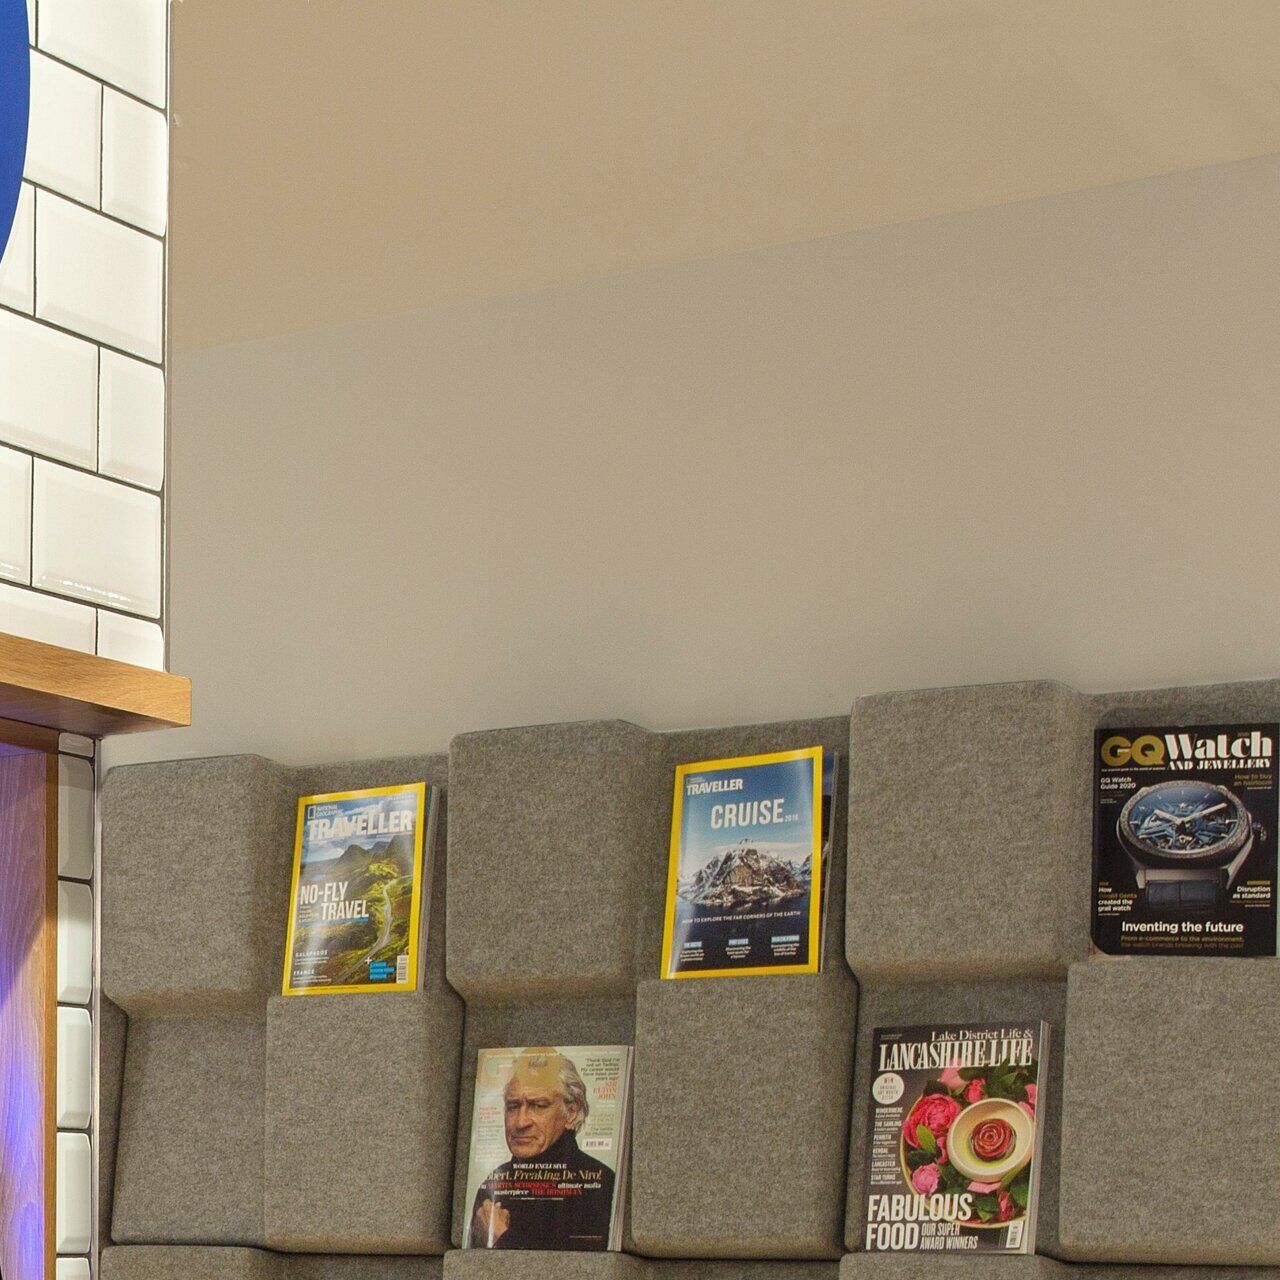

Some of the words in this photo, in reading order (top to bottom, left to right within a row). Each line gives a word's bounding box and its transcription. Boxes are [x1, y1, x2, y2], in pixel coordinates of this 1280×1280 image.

[1101, 735, 1164, 767] GQ
[1164, 731, 1272, 759] Watch
[1168, 761, 1193, 771] AND
[1196, 759, 1272, 770] JEWELLERY
[686, 779, 743, 795] TRAVELLER
[710, 798, 785, 829] CRUISE
[308, 810, 413, 841] TRAVELLER
[300, 881, 349, 904] NO-FLY
[321, 900, 369, 921] TRAVEL
[1122, 921, 1179, 934] Inventing
[1181, 921, 1202, 932] the
[1205, 921, 1244, 932] future
[931, 1031, 957, 1042] Lake
[959, 1030, 998, 1041] District
[1001, 1029, 1022, 1039] Life
[1023, 1030, 1033, 1039] &
[878, 1041, 986, 1071] LANCASHIRE
[989, 1039, 1033, 1066] LIFE
[562, 1170, 577, 1180] De
[868, 1193, 973, 1221] FABULOUS
[866, 1223, 919, 1250] FOOD
[921, 1223, 936, 1235] OUR
[937, 1223, 960, 1235] SUPER
[920, 1237, 945, 1249] AWARD
[946, 1236, 978, 1249] WINNERS
